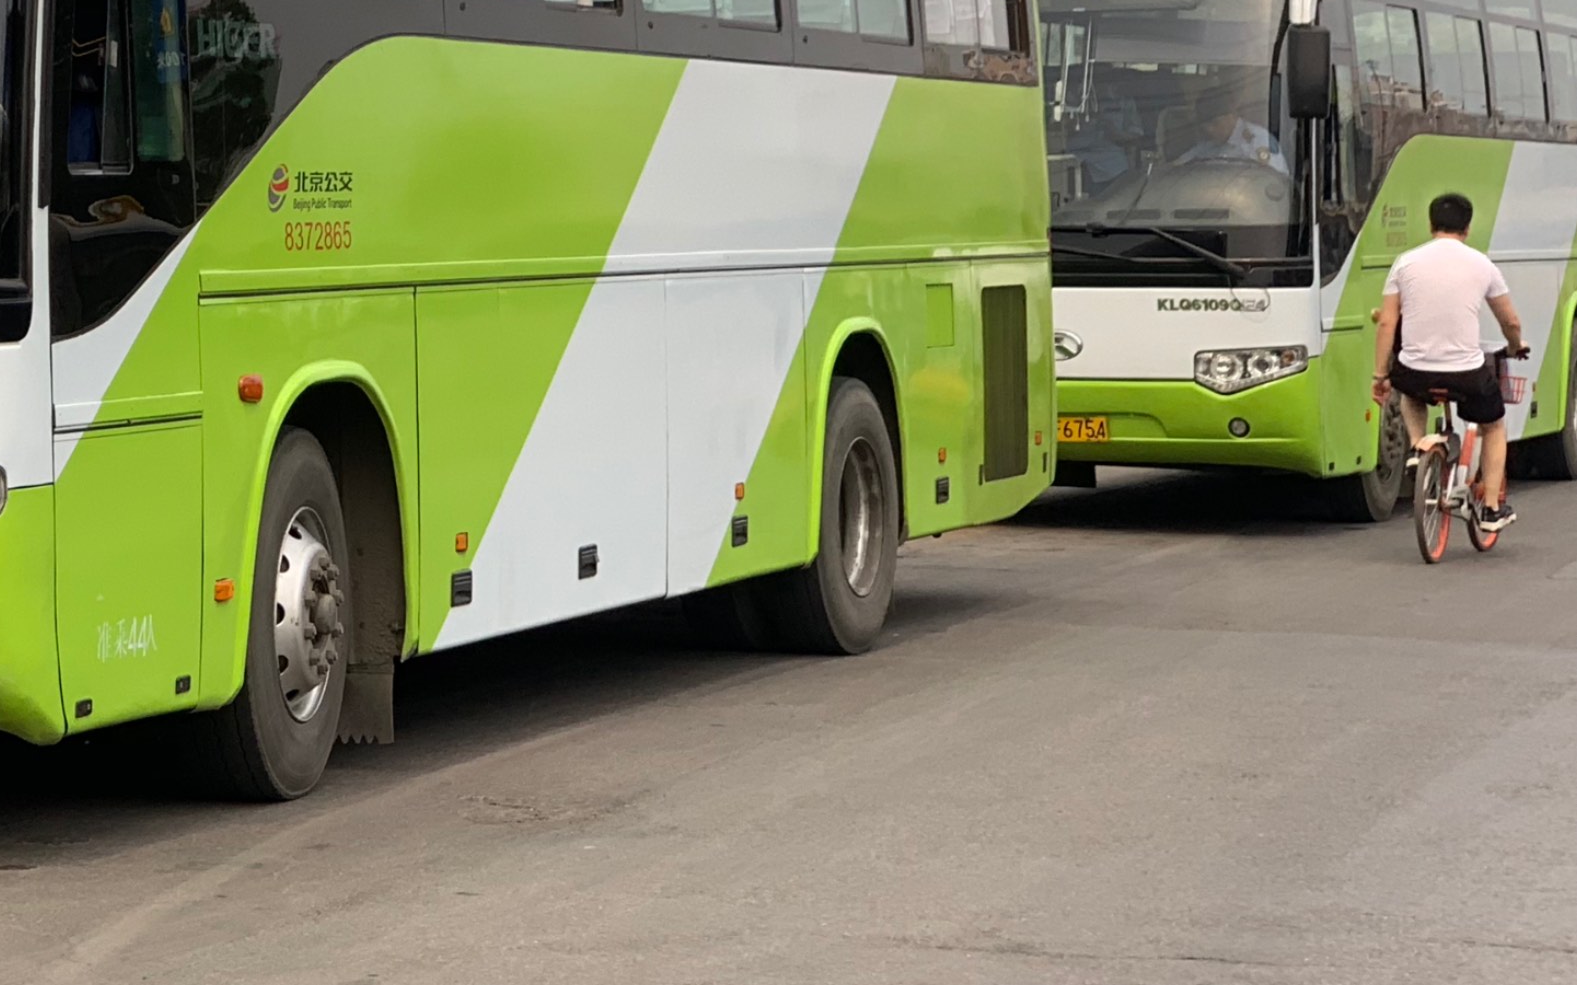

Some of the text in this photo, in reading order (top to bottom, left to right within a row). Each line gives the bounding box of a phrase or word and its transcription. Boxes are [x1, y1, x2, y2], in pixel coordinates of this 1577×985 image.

[294, 171, 353, 193] 北京公交
[293, 198, 352, 212] Beijing Public Transport
[285, 221, 352, 251] 8372865
[1057, 420, 1106, 439] 675A
